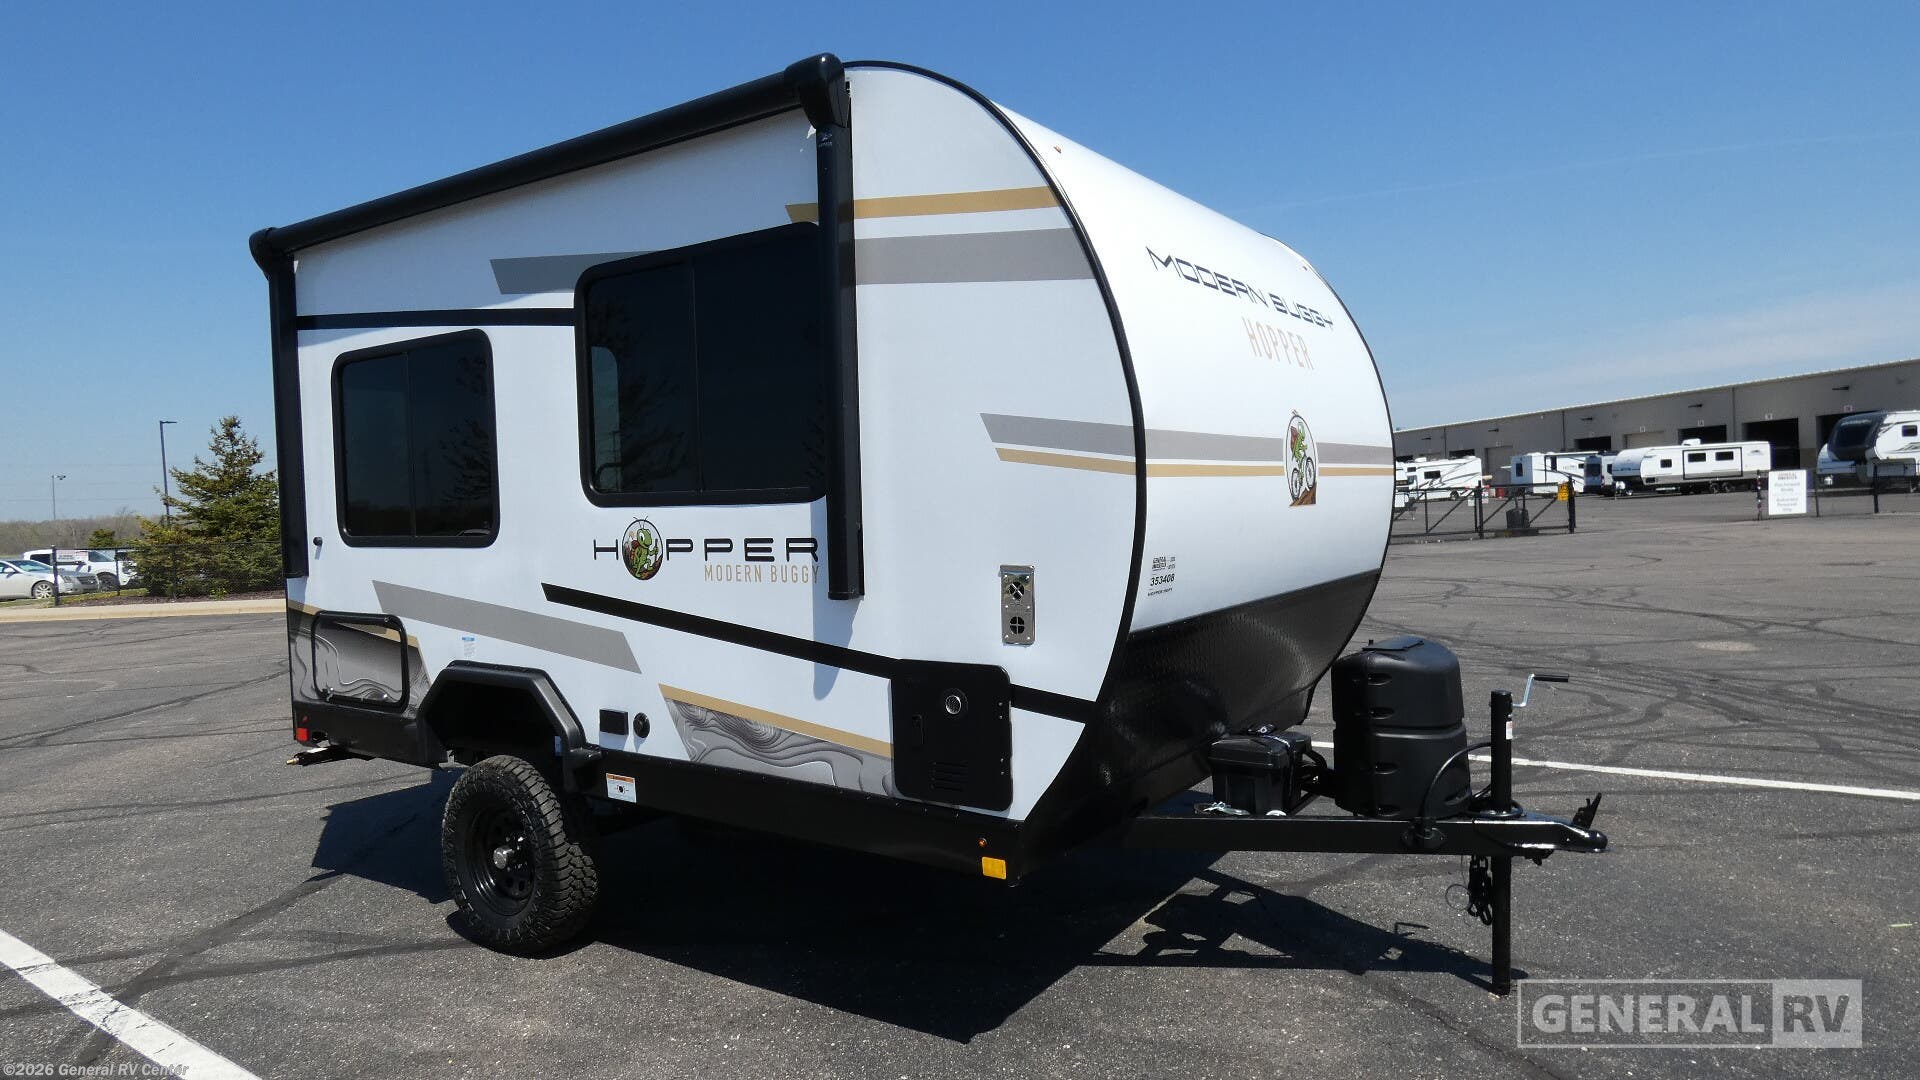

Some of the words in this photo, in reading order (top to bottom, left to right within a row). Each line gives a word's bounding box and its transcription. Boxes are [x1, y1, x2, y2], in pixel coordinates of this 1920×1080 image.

[1145, 246, 1269, 308] MODERN
[1269, 293, 1334, 331] BUGGY
[1242, 317, 1315, 370] HOPPER
[593, 519, 819, 581] HOPPER
[704, 564, 762, 583] MODERN
[770, 565, 820, 584] BUGGY
[1150, 573, 1175, 586] 353408
